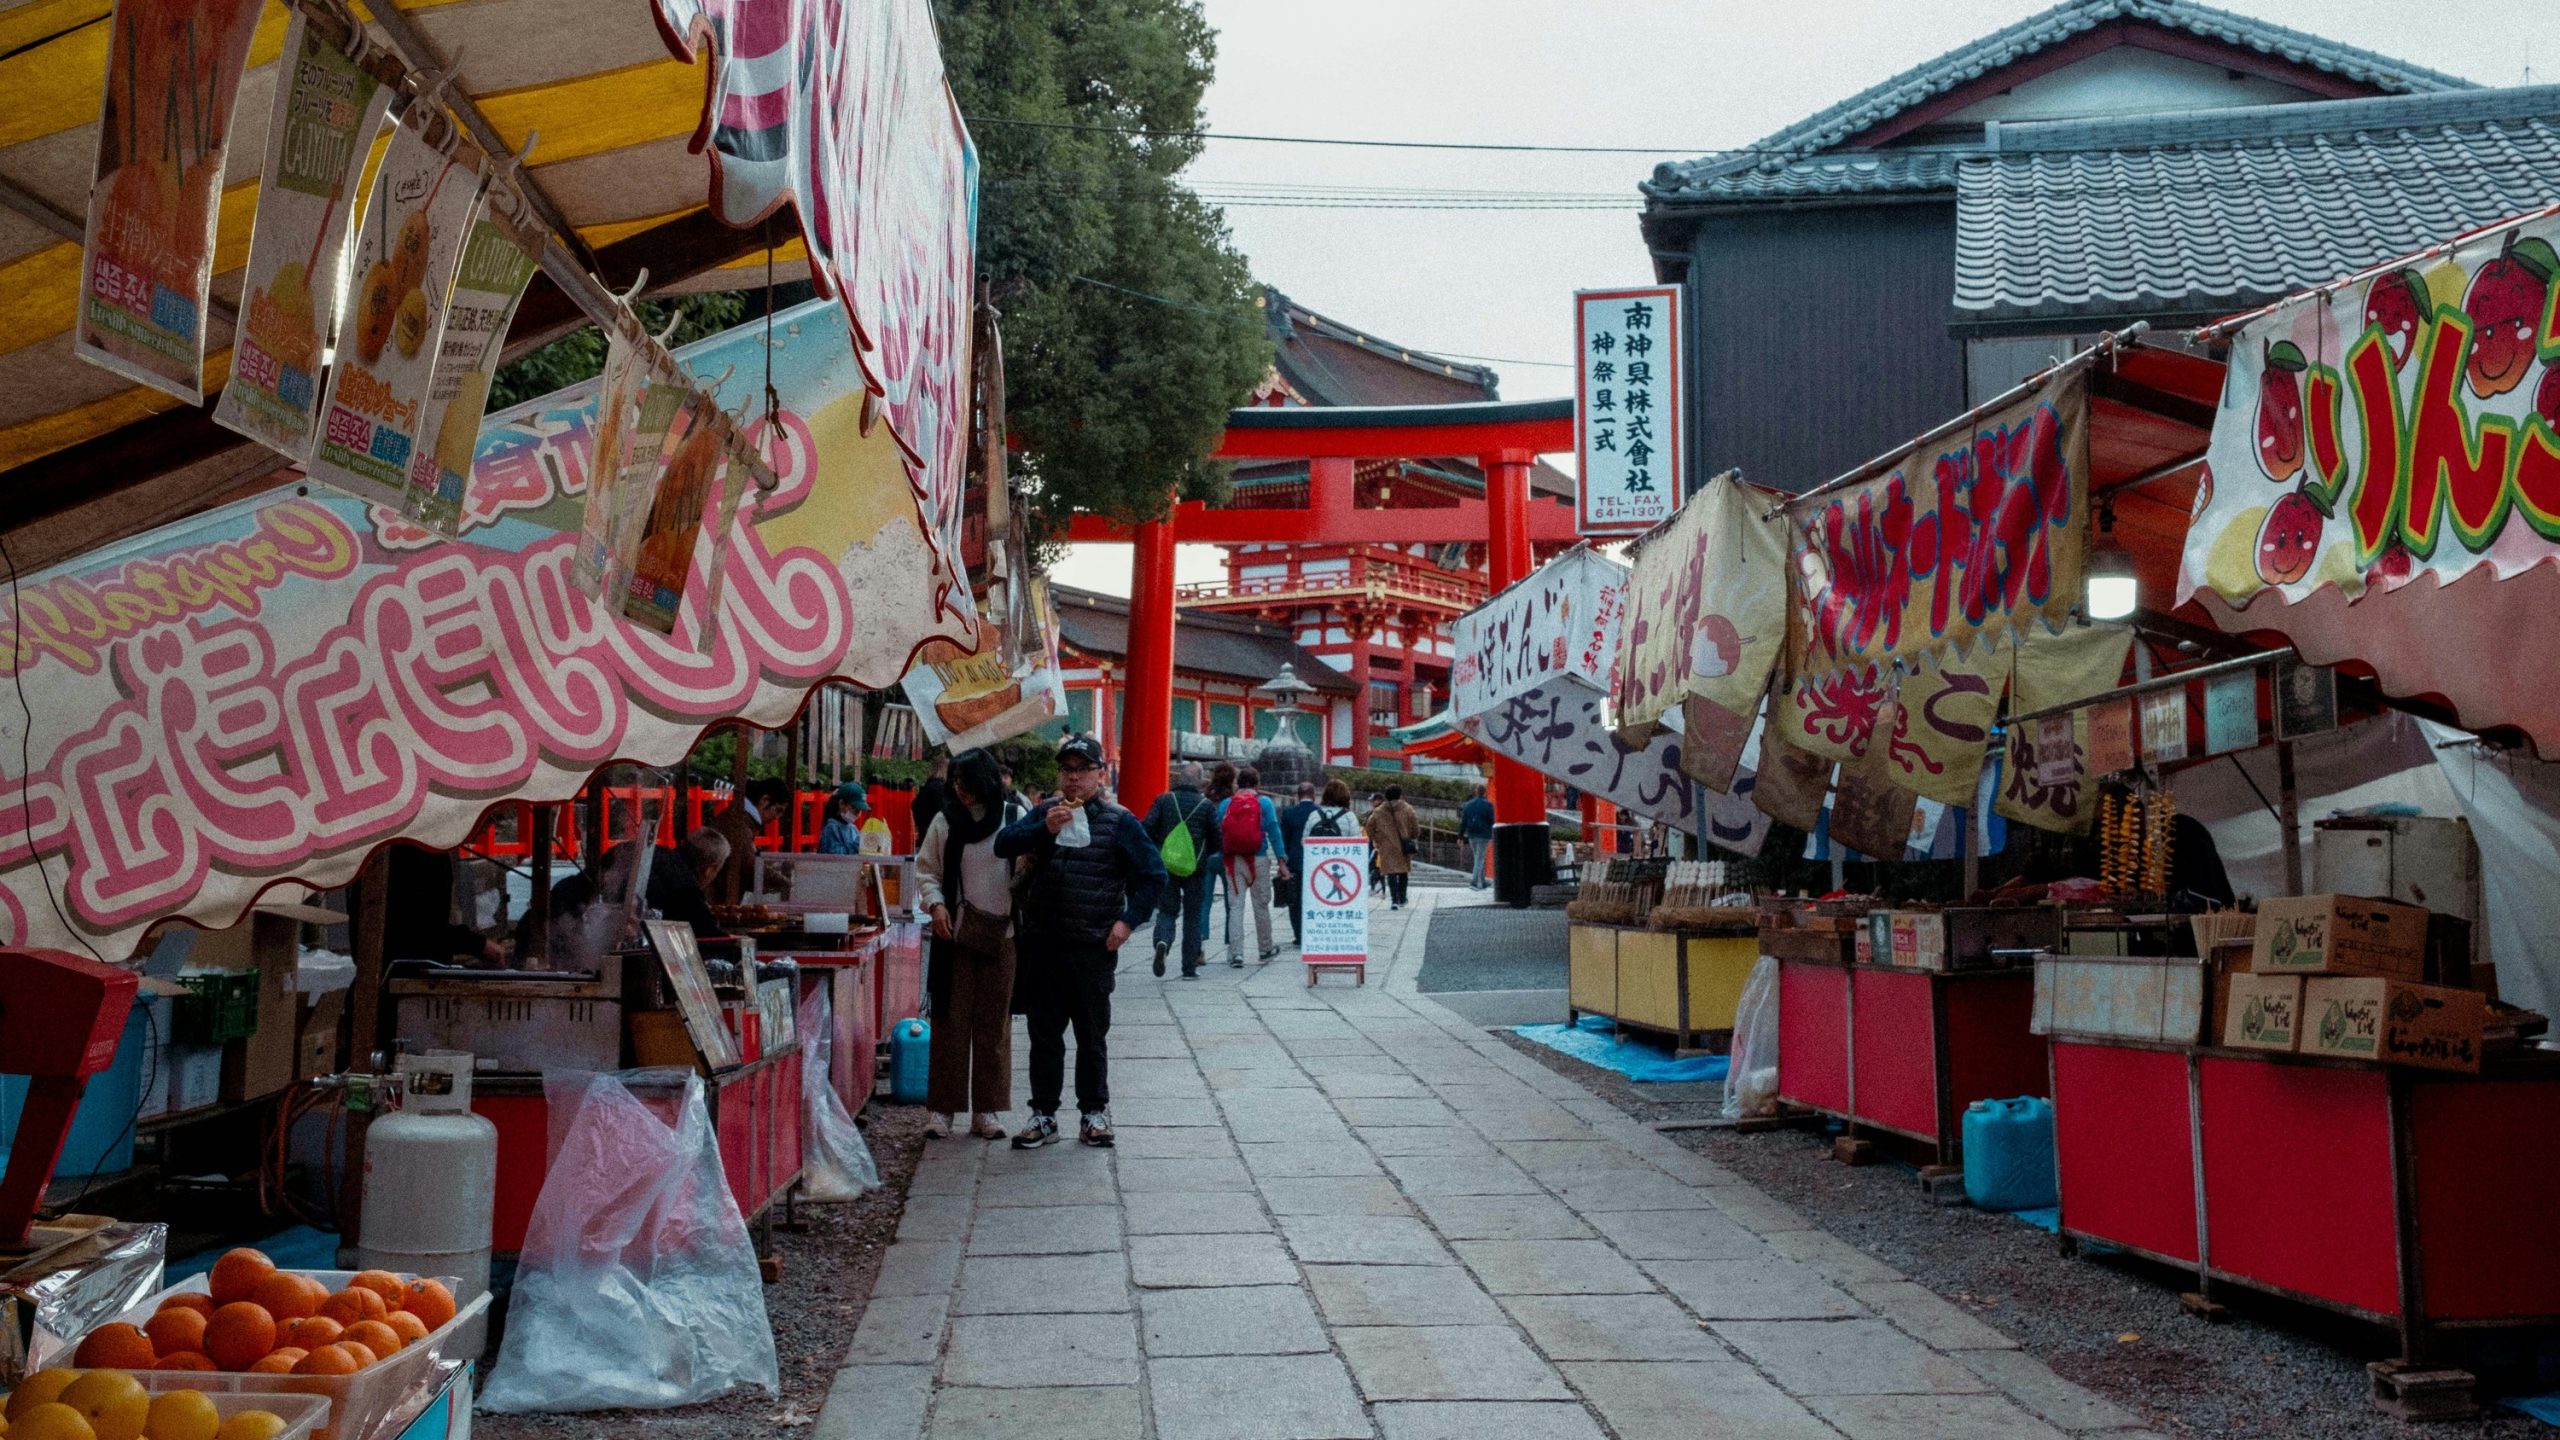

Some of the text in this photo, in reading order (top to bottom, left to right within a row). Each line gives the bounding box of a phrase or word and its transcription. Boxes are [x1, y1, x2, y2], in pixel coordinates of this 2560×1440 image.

[1591, 330, 1617, 453] 神祭具一式
[1623, 301, 1656, 494] 南神具株式會社
[1595, 506, 1665, 519] 641-1307
[1310, 845, 1362, 856] これより先
[1306, 909, 1364, 921] 食べ歩き禁止
